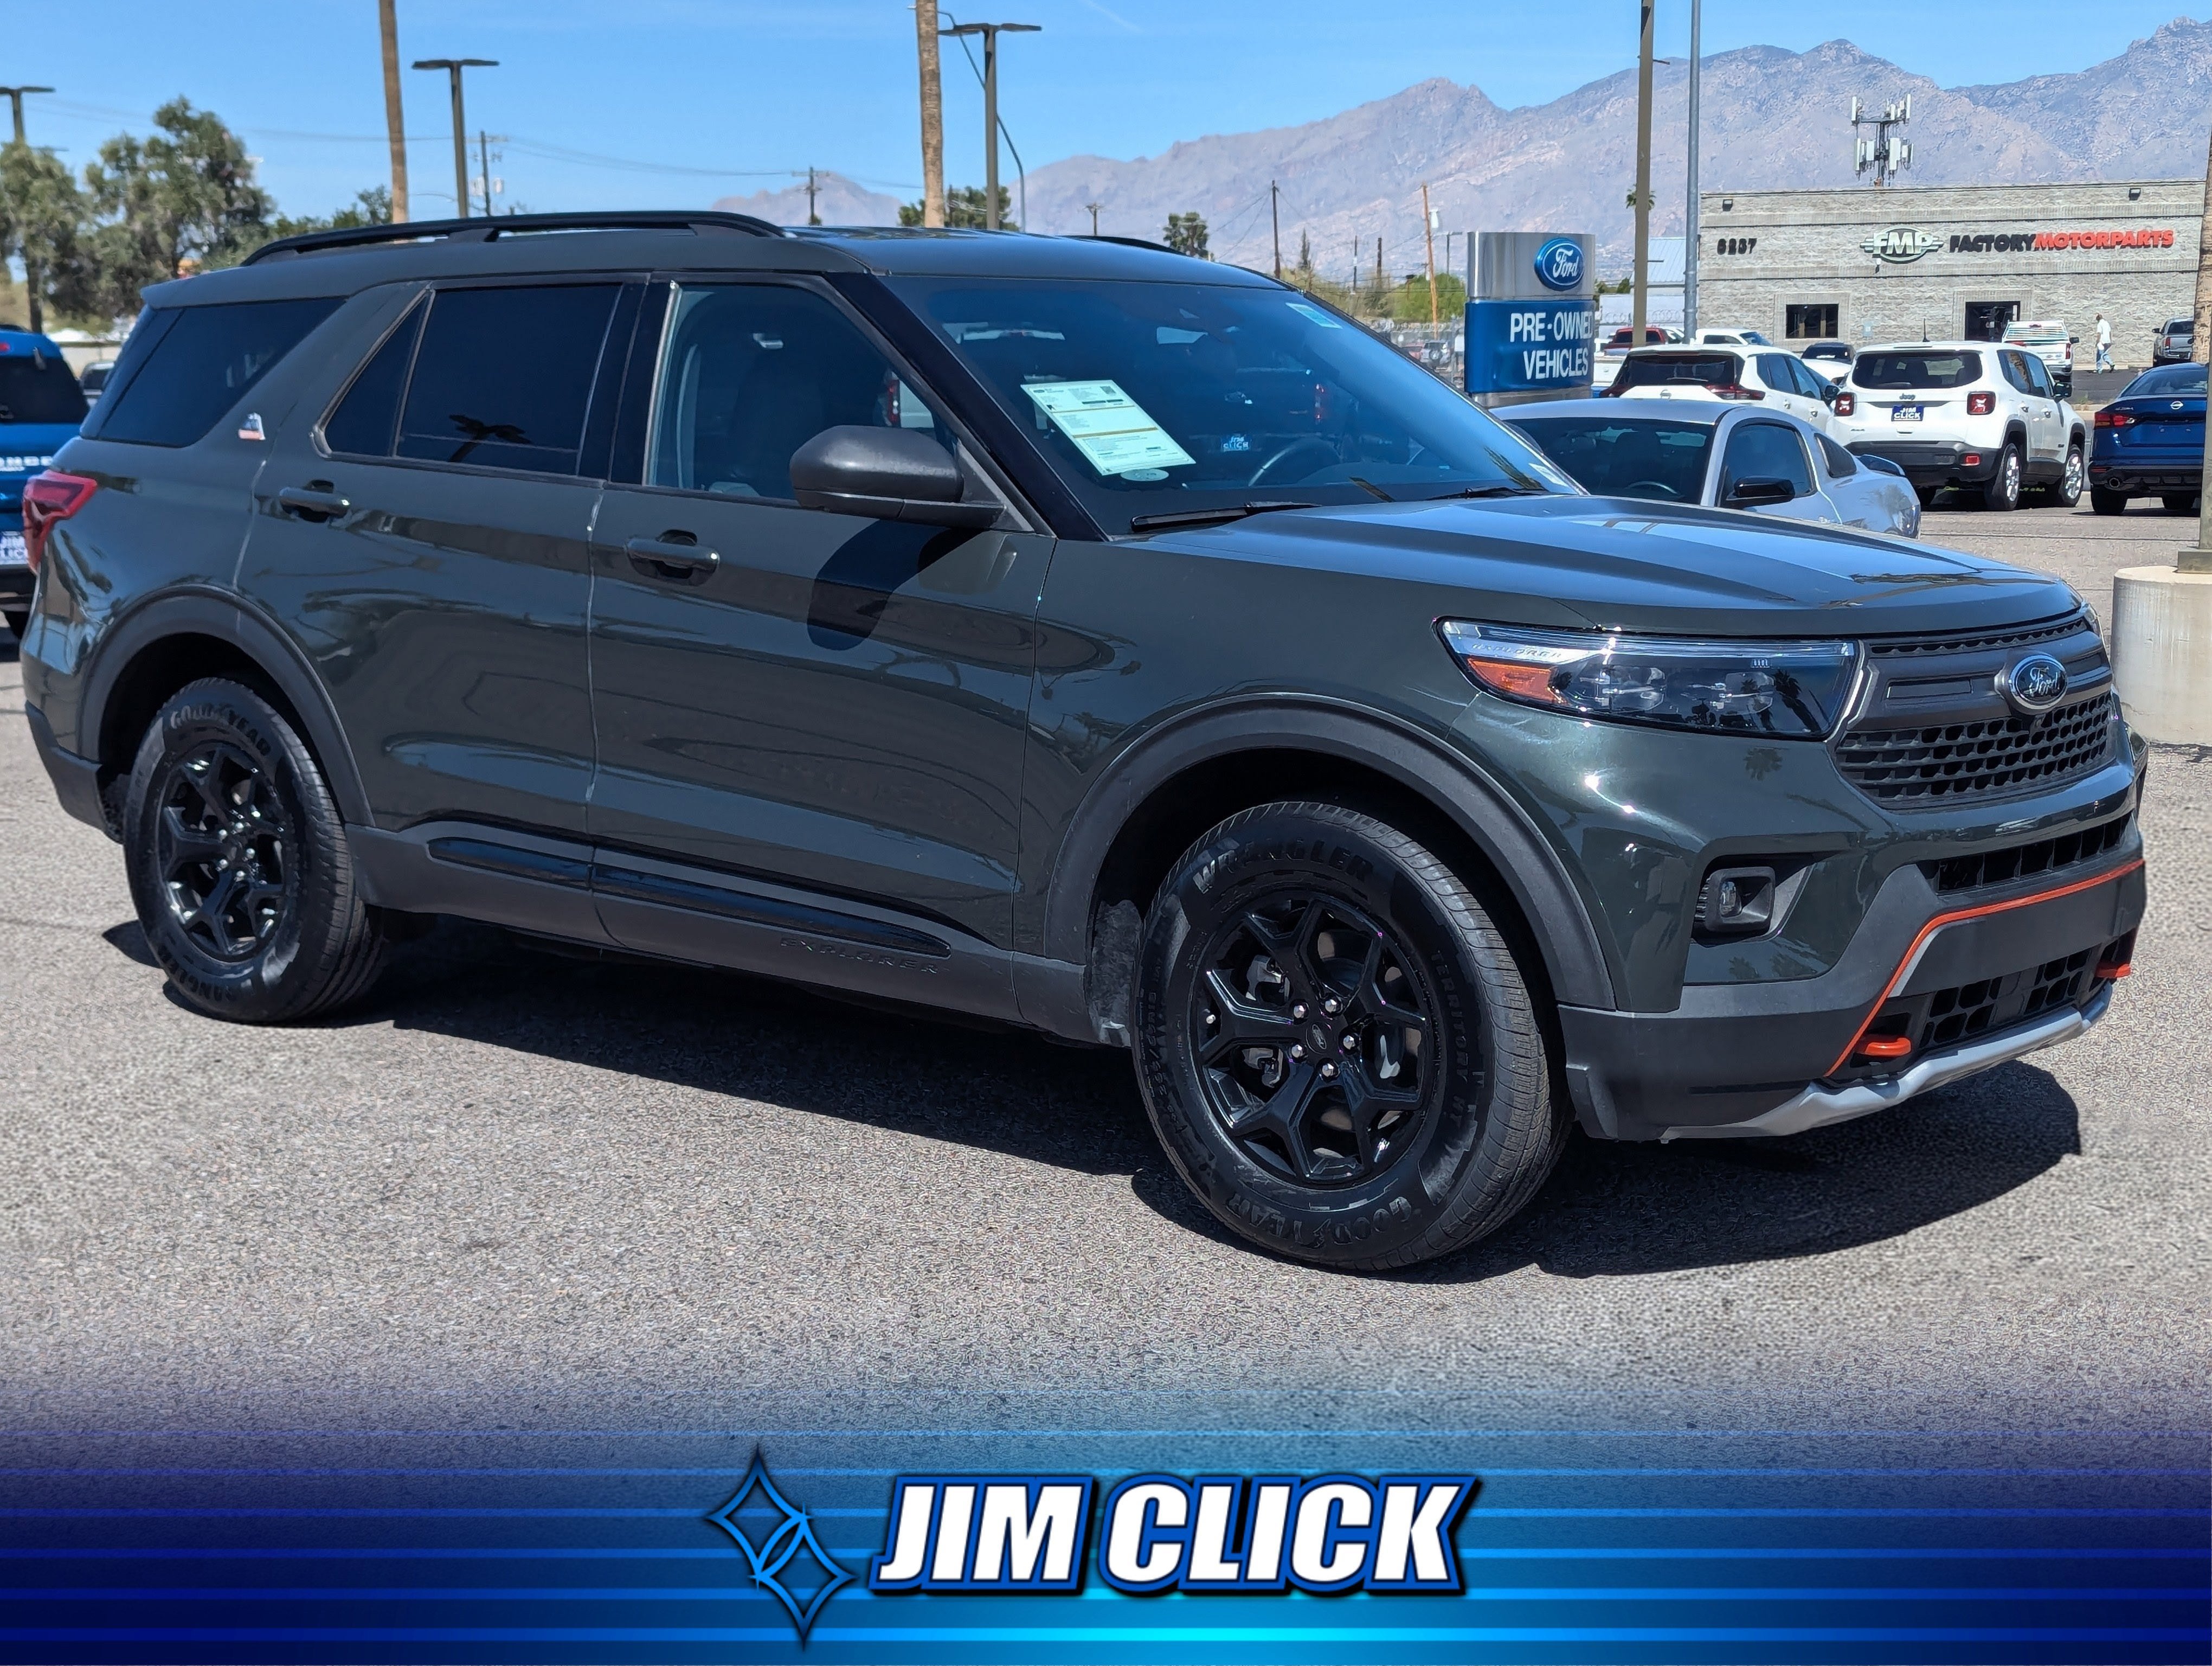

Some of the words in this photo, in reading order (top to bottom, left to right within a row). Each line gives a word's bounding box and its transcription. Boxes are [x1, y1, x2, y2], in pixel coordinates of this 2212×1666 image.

[1872, 232, 1934, 255] FMP
[1510, 311, 1593, 342] PRE-OWNED
[1523, 348, 1589, 380] VEHICLES
[1192, 838, 1374, 895] WRANGLER
[780, 937, 938, 975] EXPLORER
[1225, 1193, 1413, 1250] GOODYEAR
